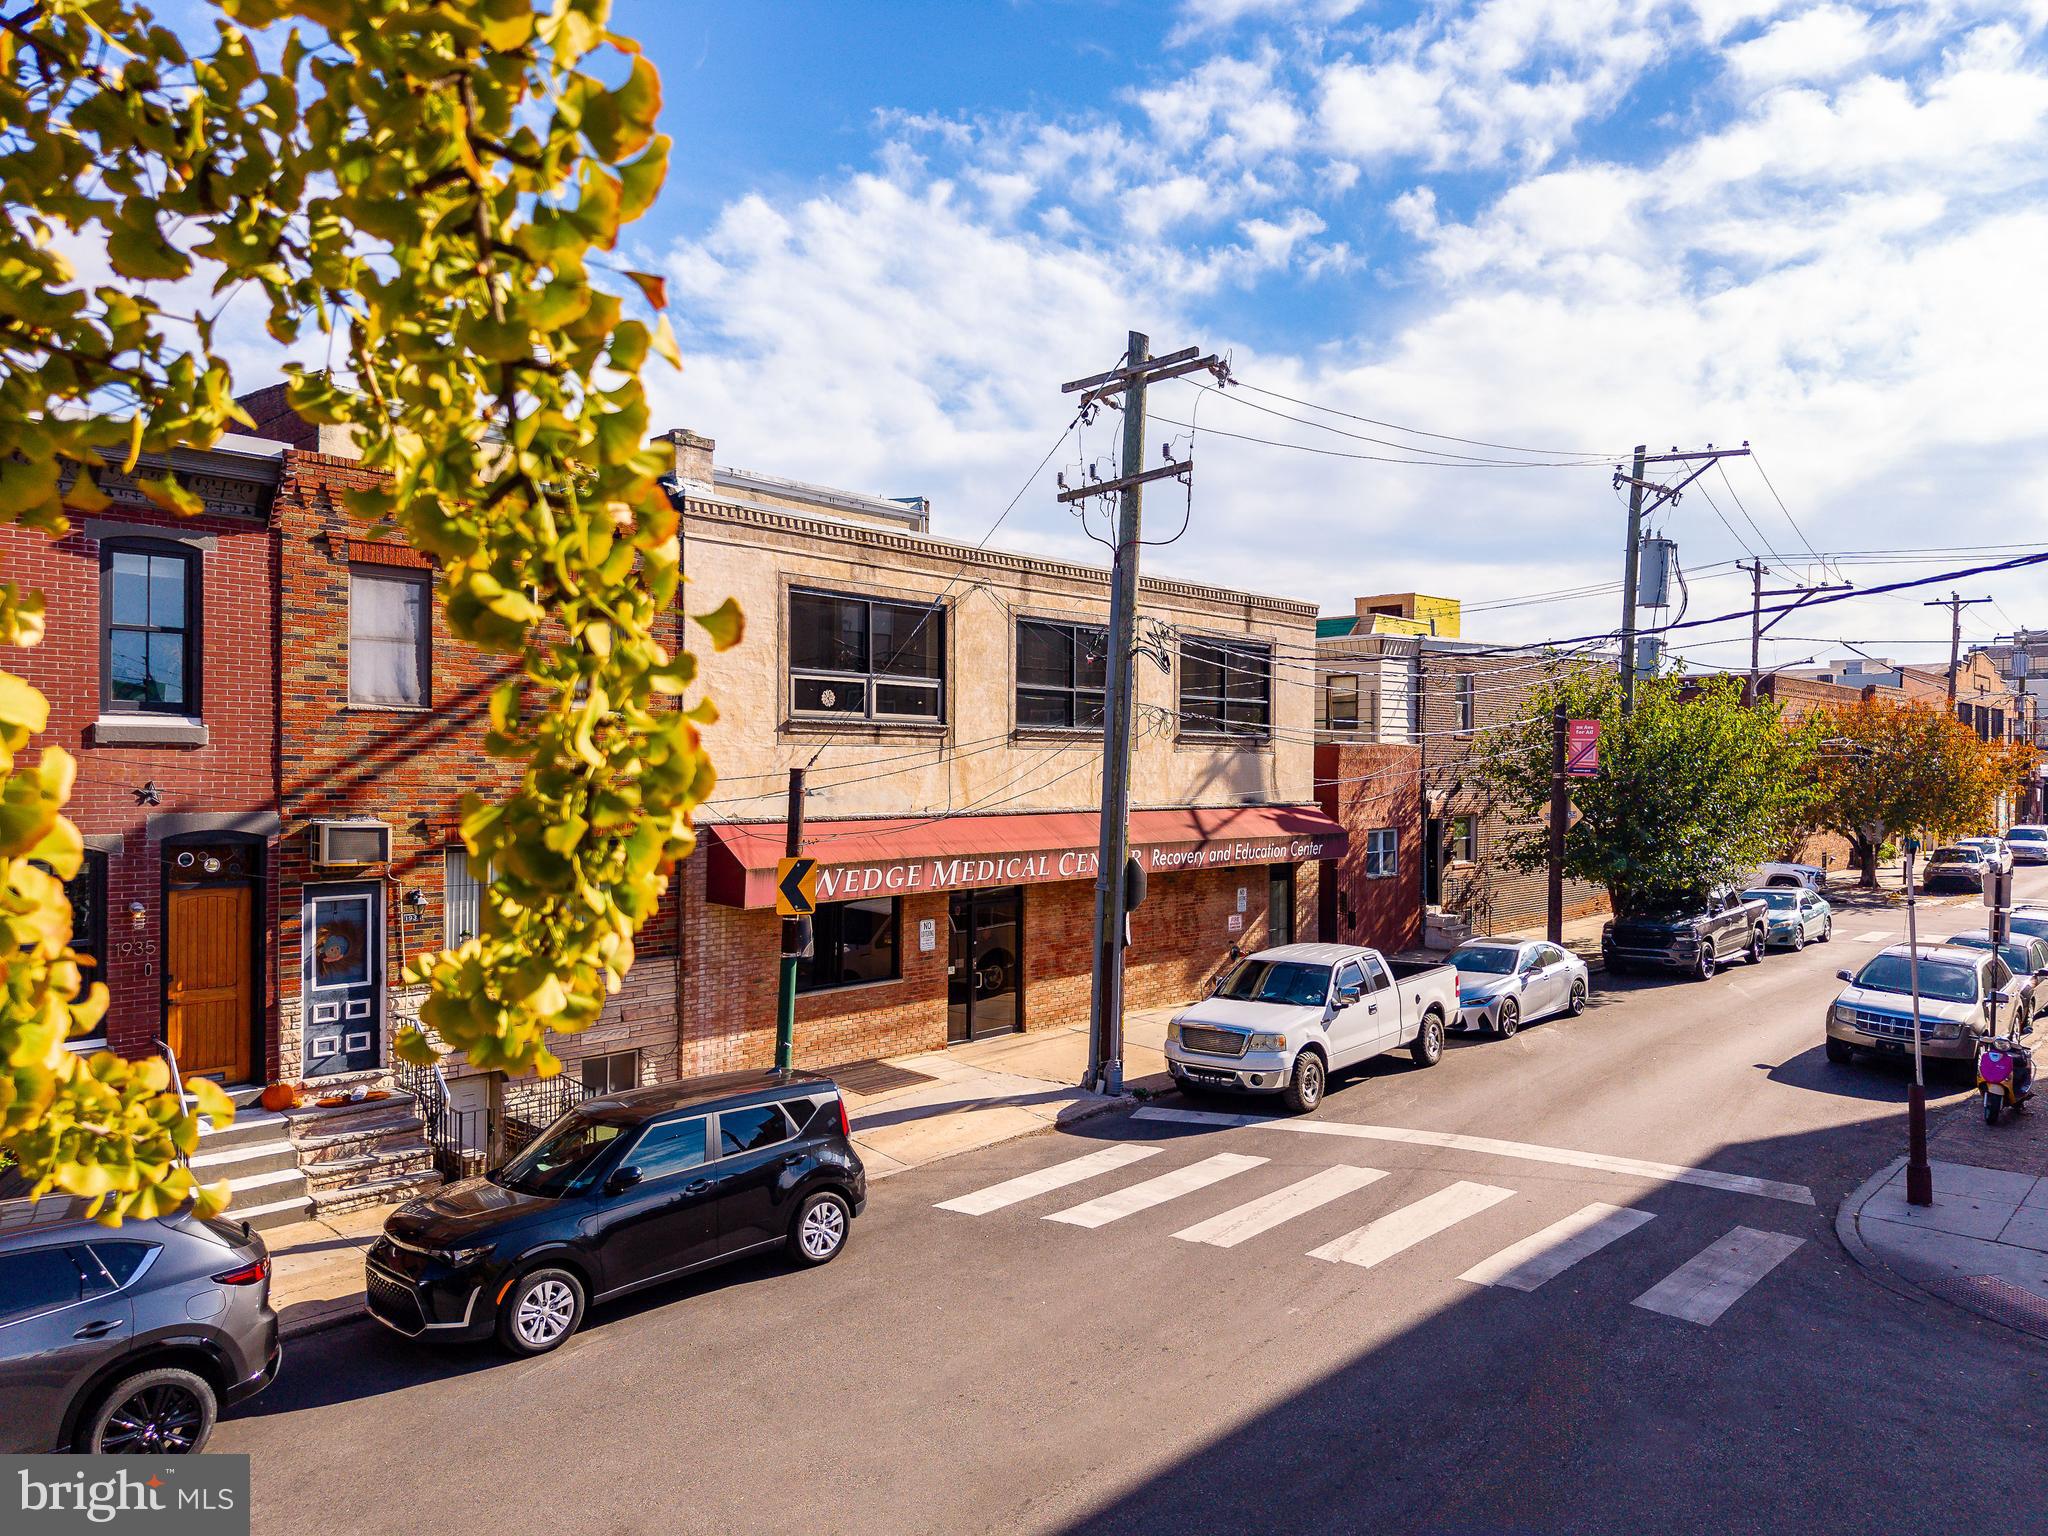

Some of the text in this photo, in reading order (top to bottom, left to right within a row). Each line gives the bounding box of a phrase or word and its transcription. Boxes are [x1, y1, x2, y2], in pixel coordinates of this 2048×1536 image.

[1152, 840, 1323, 867] Recovery and Education Center
[815, 850, 1143, 897] WEDGE MEDICAL CENR
[923, 921, 932, 930] NO
[112, 940, 156, 957] 1935
